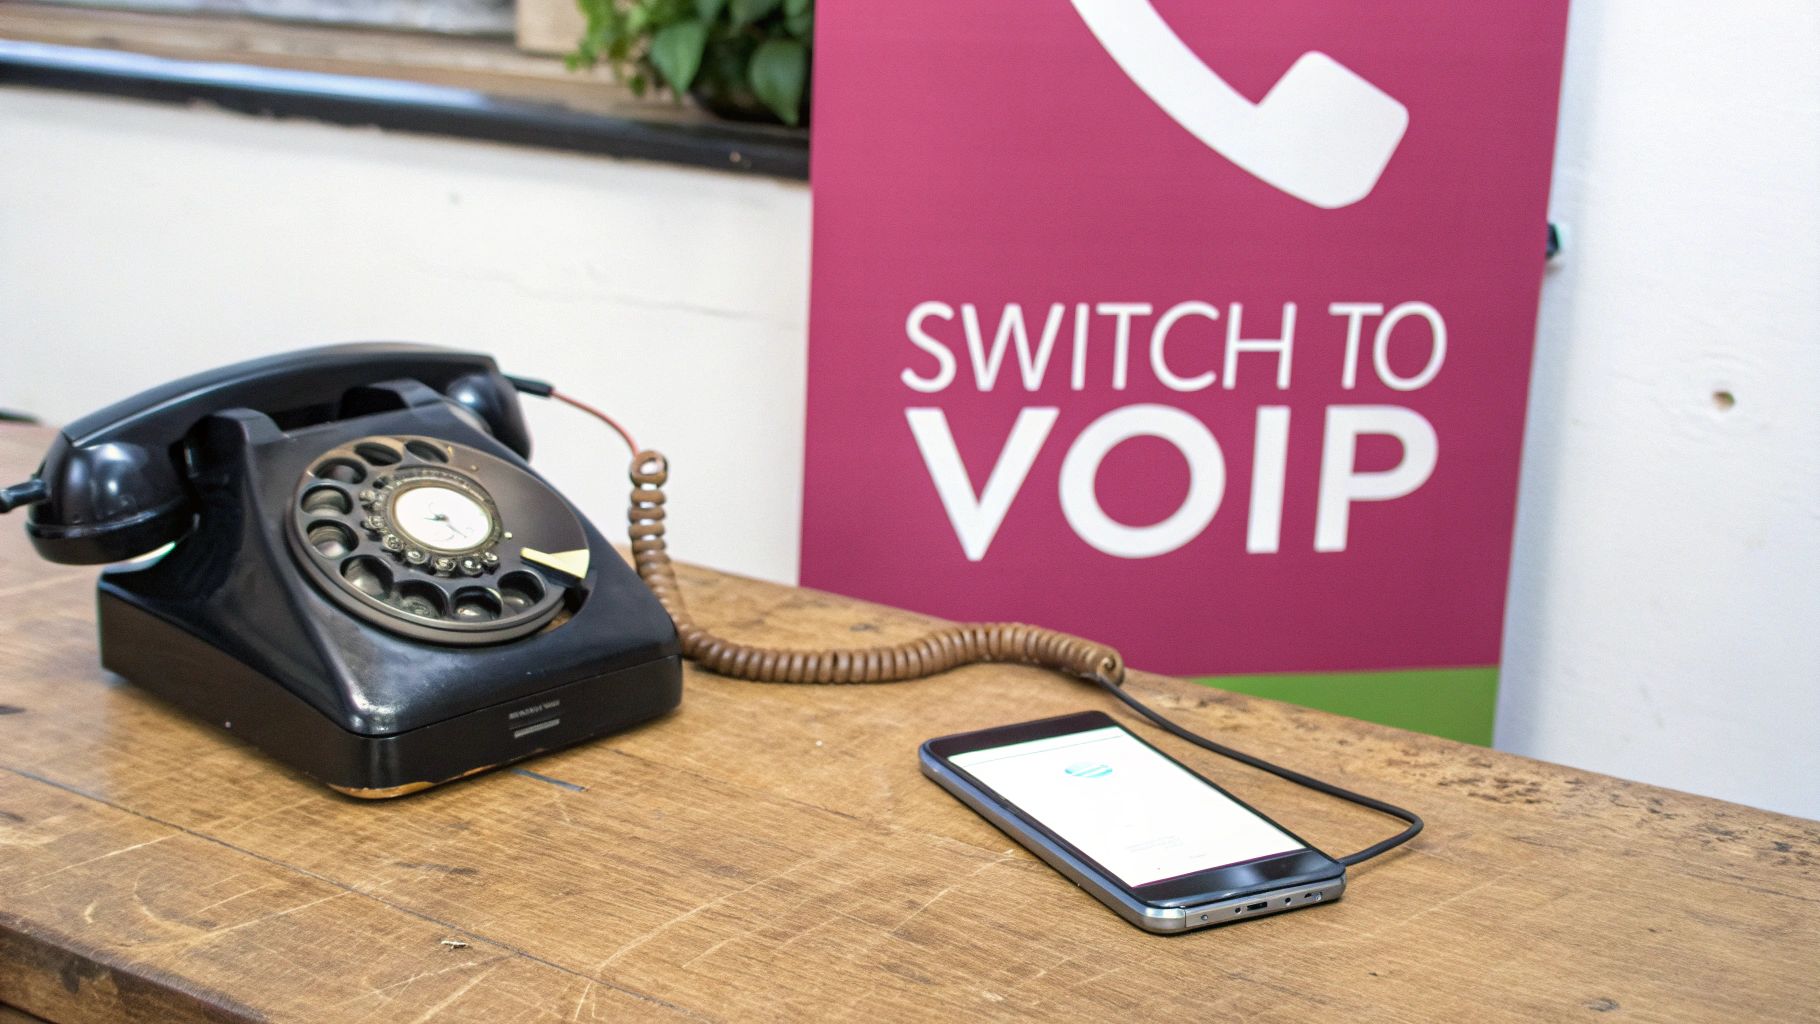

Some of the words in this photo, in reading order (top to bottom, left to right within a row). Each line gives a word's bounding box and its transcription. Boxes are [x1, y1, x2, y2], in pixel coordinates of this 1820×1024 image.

[900, 300, 1297, 392] SWITCH
[1328, 300, 1447, 391] TO
[904, 403, 1438, 562] VOIP
